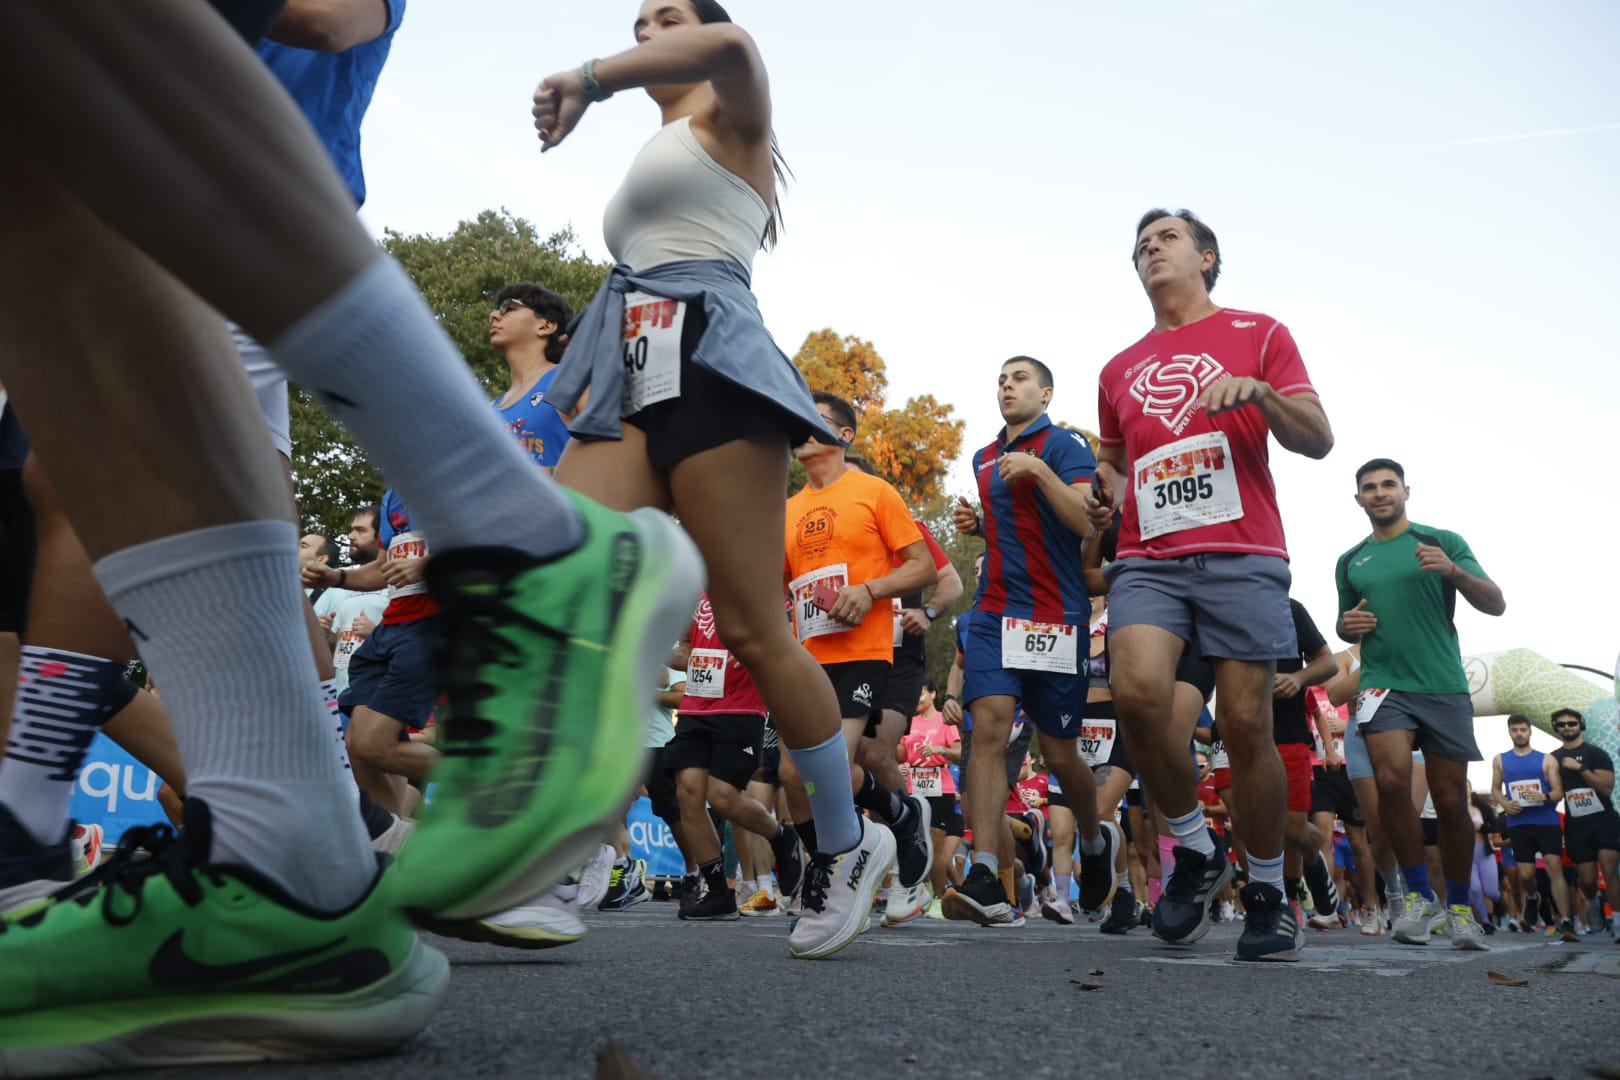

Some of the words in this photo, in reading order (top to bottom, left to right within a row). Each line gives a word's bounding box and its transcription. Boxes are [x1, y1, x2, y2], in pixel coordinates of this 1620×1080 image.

[1154, 473, 1213, 509] 3095
[804, 518, 826, 535] 25
[1025, 633, 1058, 653] 657
[692, 669, 712, 684] 1254
[1081, 739, 1101, 754] 327
[916, 779, 935, 789] 4072
[847, 849, 871, 891] HOKA
